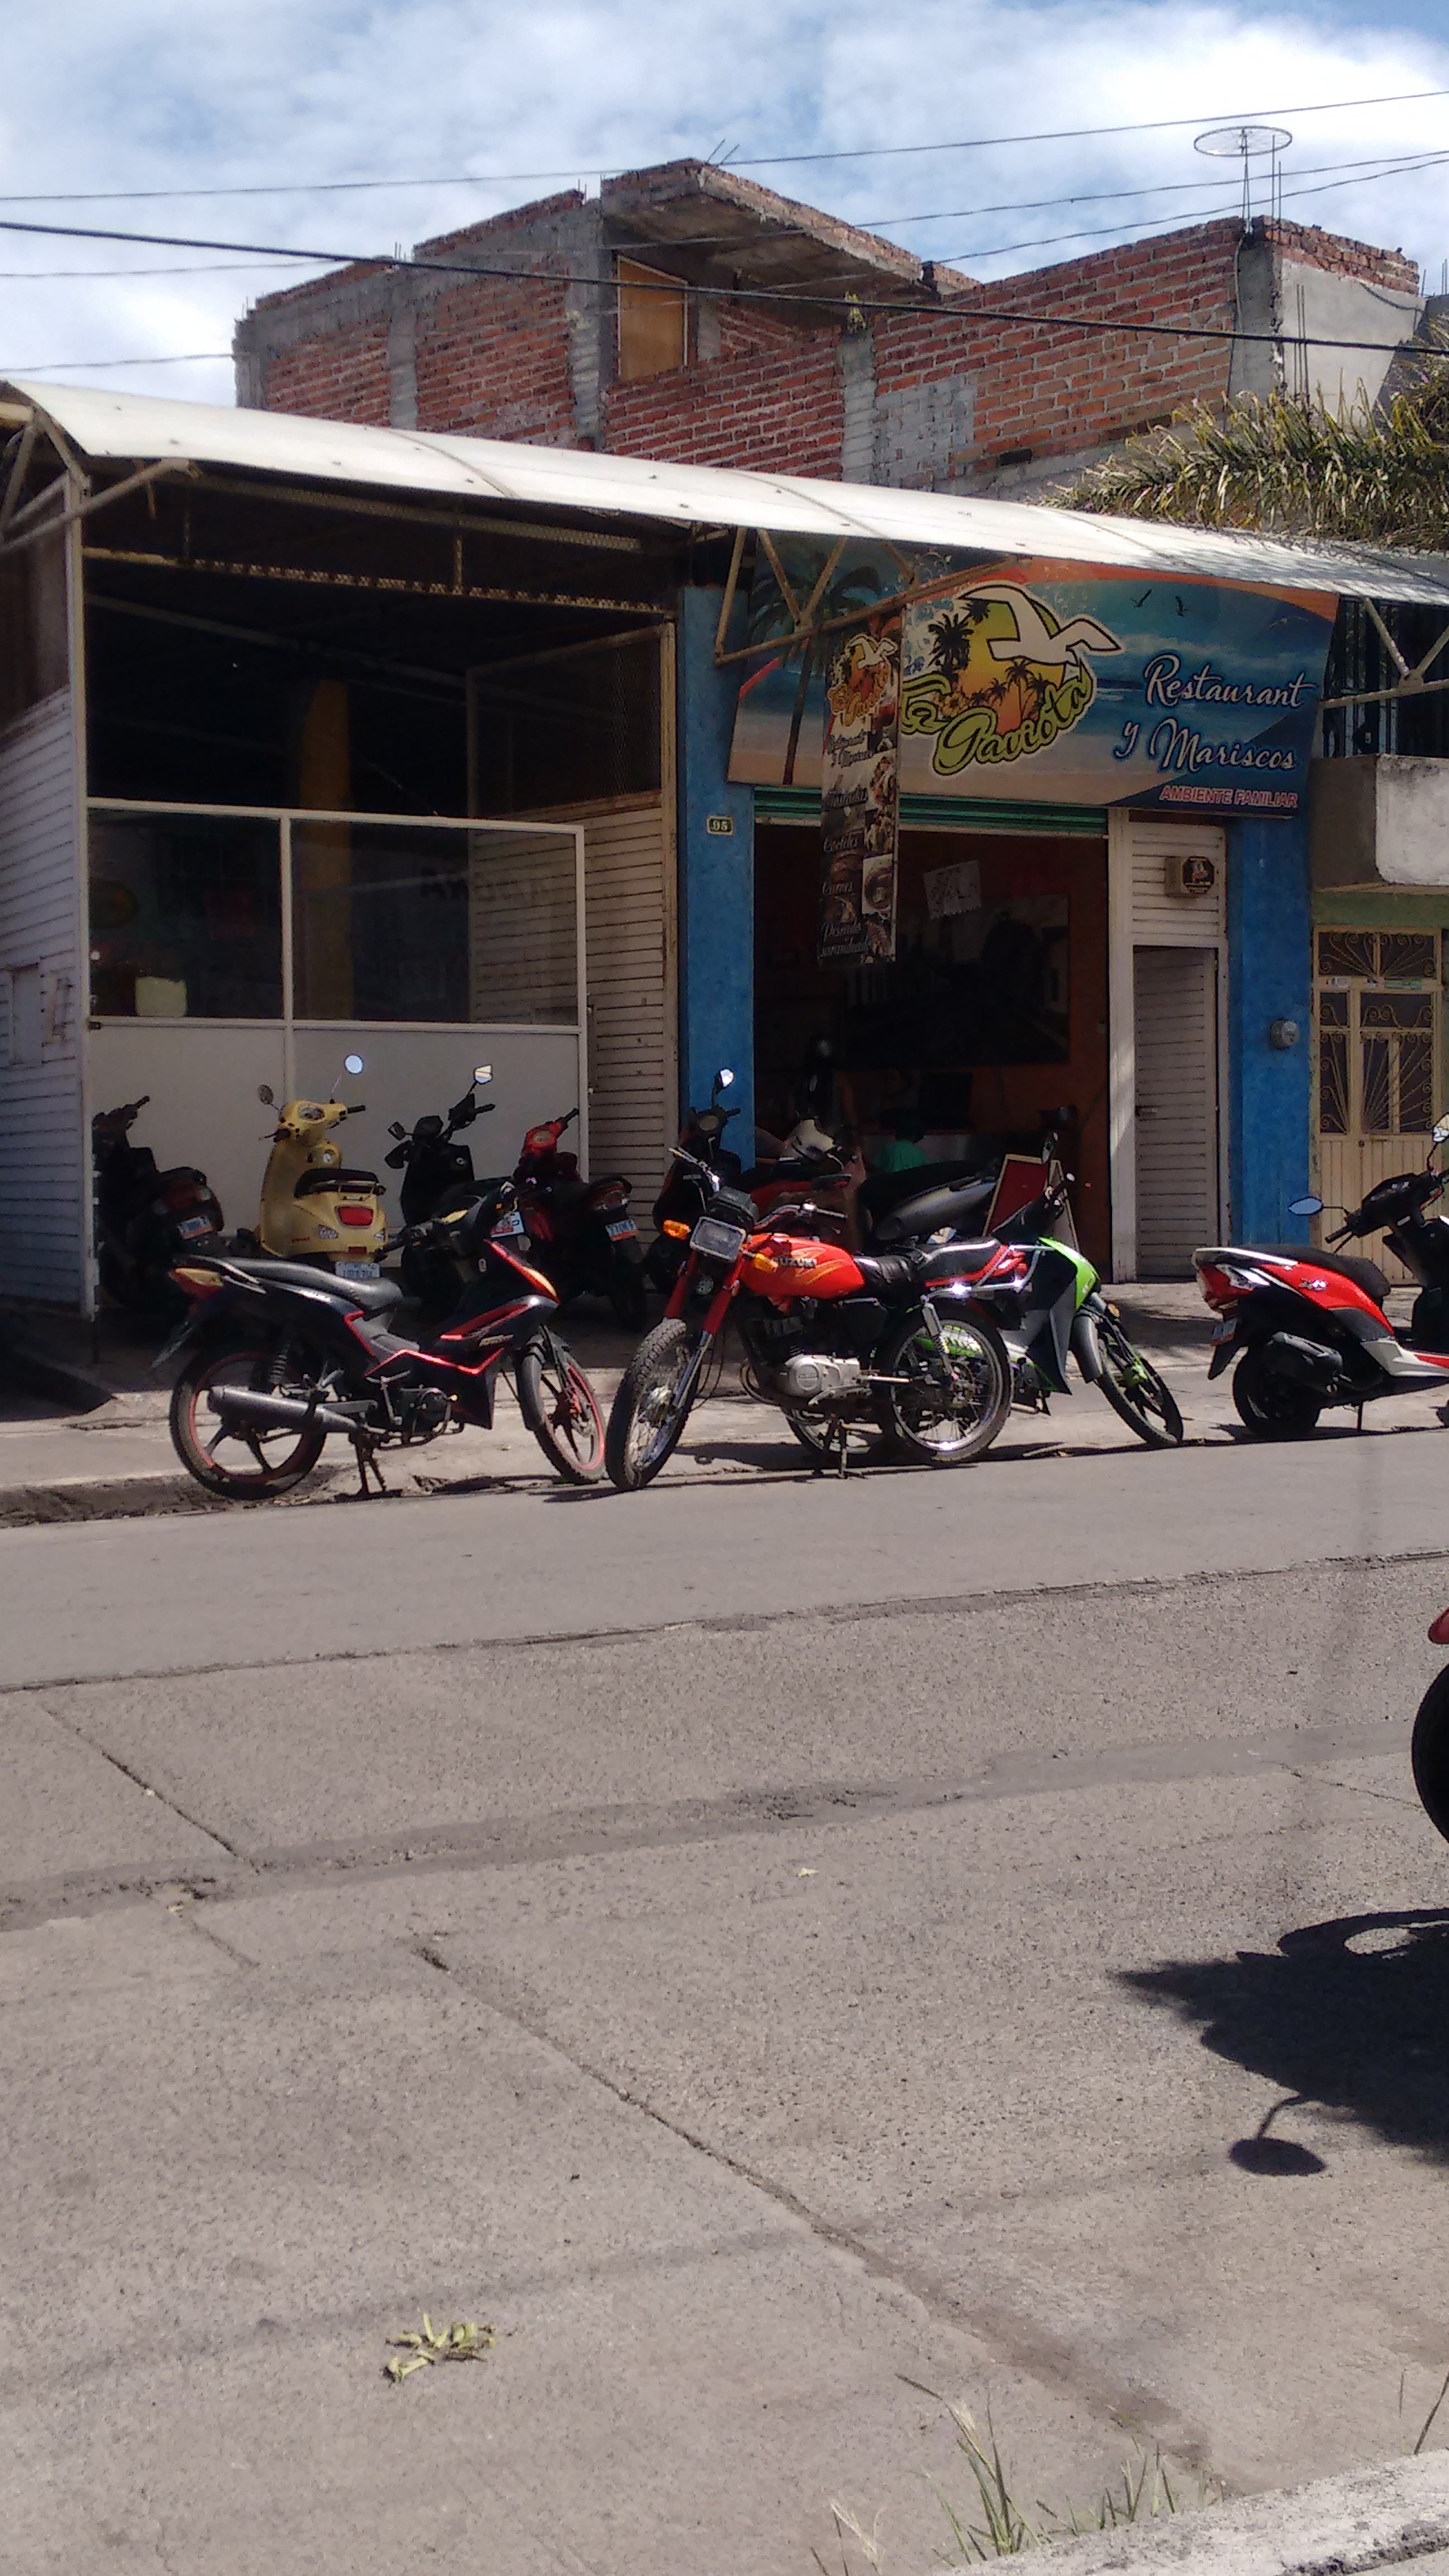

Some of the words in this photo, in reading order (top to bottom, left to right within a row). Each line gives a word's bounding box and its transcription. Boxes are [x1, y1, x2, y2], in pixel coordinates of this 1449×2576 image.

[1144, 653, 1319, 709] Restaurant
[932, 661, 1092, 776] Gaviota
[1114, 719, 1140, 759] y
[1148, 717, 1297, 773] Mariscos
[1159, 784, 1234, 805] AMBIENTE
[1234, 788, 1299, 808] FAMILIAR
[712, 819, 728, 831] 95
